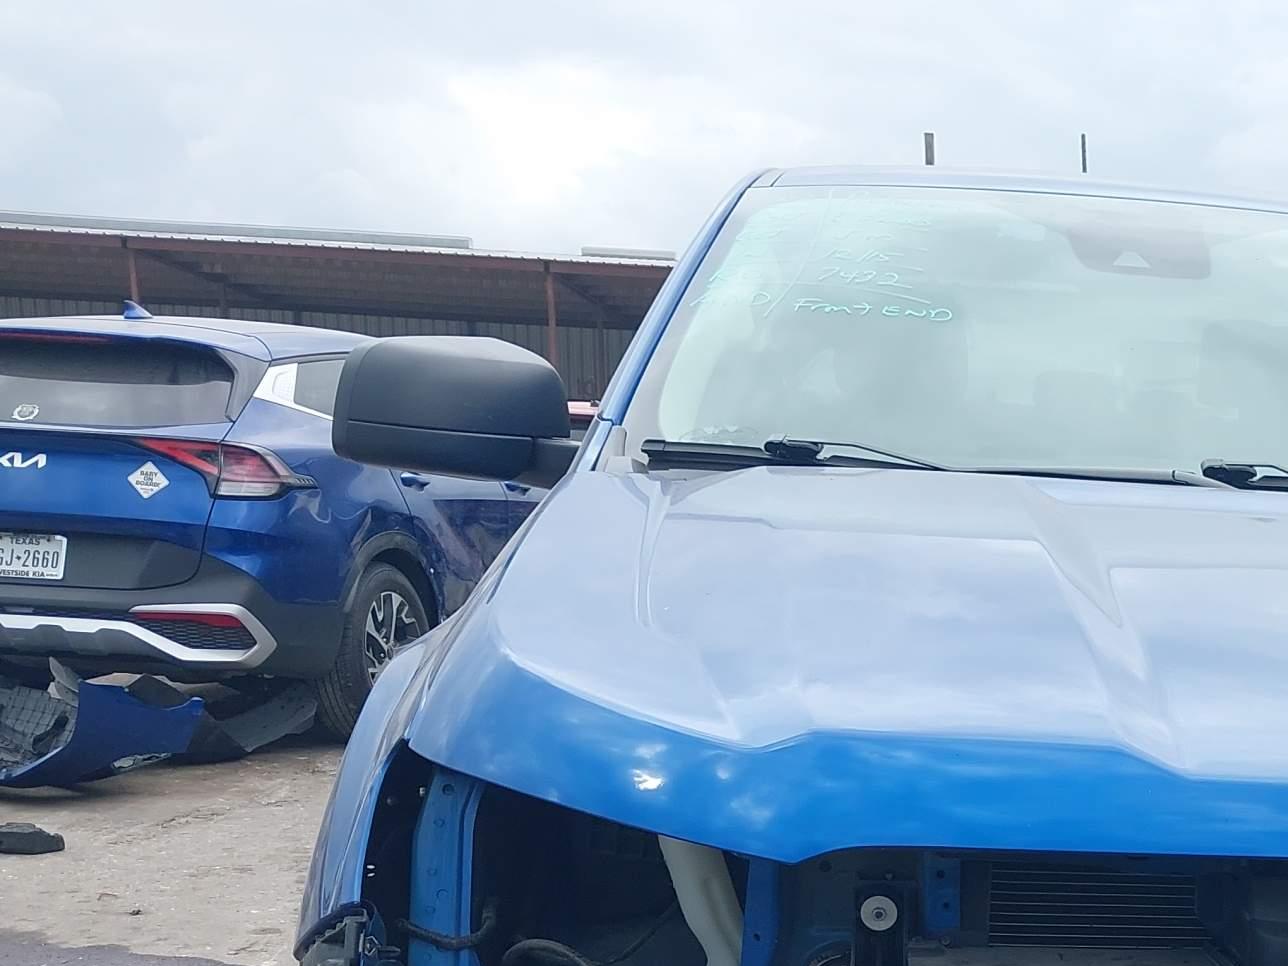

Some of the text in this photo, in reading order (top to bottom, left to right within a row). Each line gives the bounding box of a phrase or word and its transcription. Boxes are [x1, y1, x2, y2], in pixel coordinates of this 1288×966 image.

[882, 306, 953, 322] END
[140, 470, 158, 478] BABY
[10, 536, 41, 546] TEXAS
